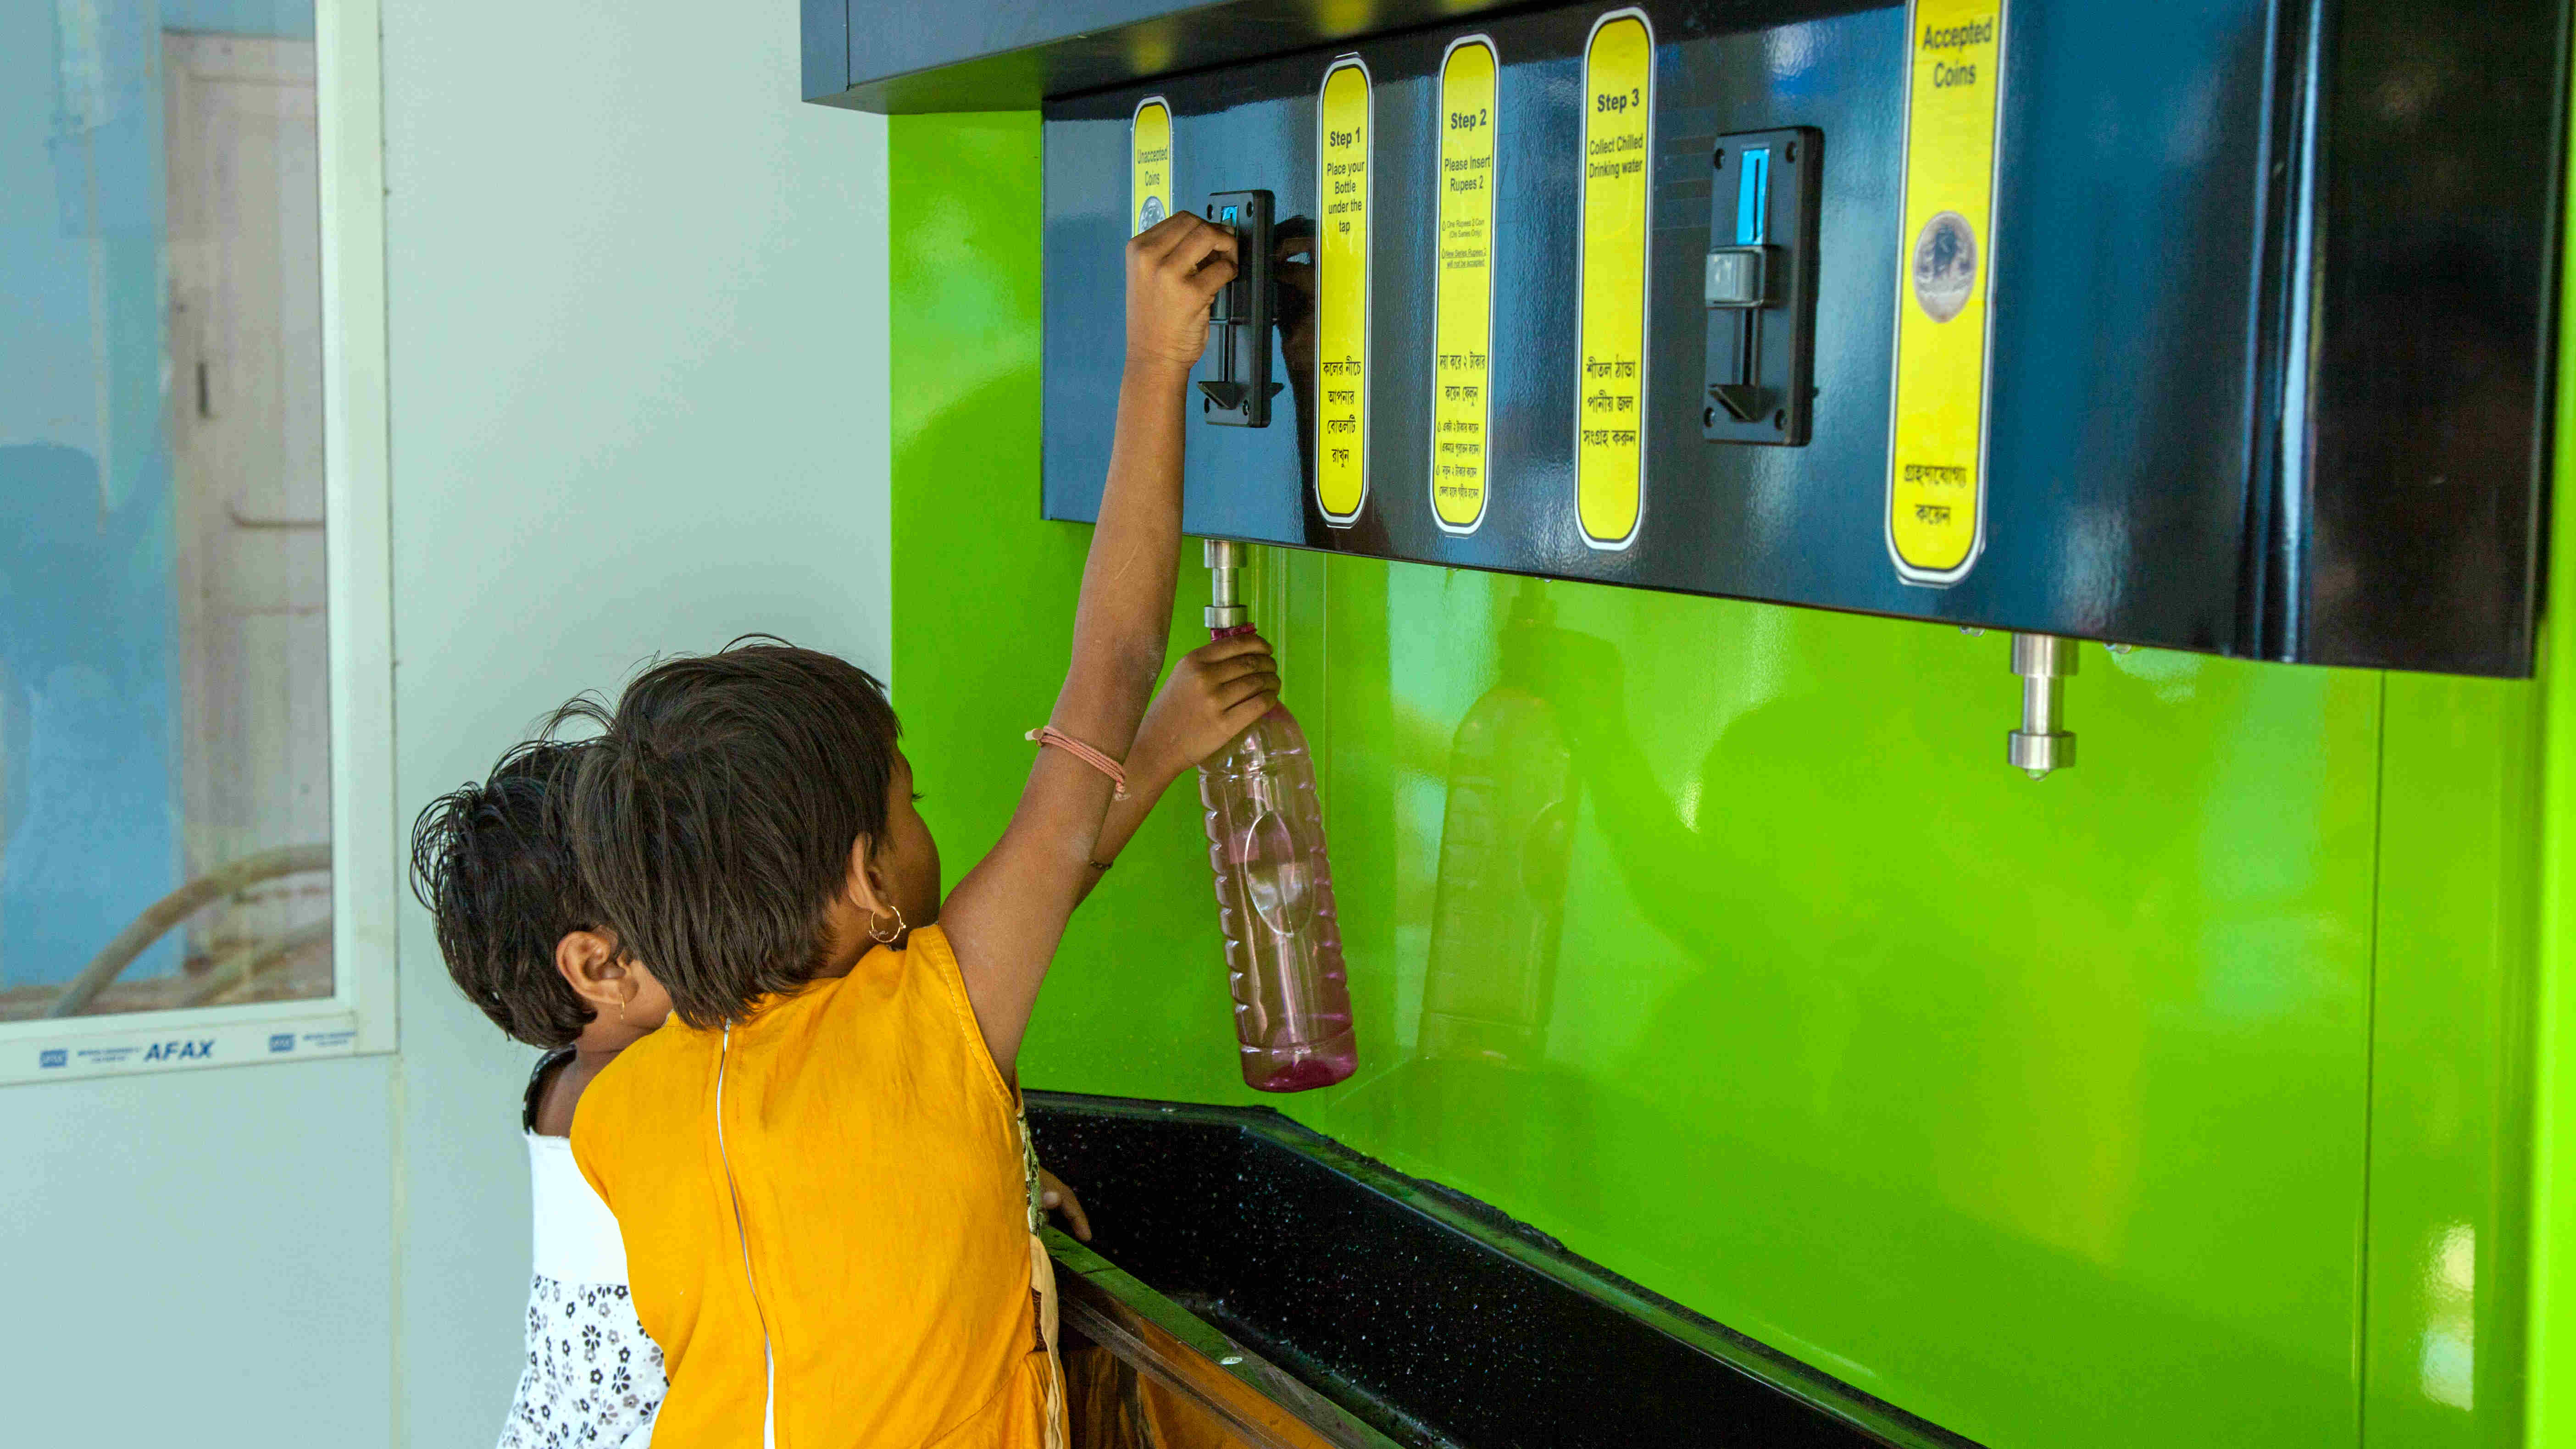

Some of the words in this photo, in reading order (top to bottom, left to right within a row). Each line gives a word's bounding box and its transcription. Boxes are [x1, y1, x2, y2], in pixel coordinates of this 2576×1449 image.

[1922, 16, 1993, 53] Accepted
[1934, 60, 1976, 87] Coins
[1597, 94, 1627, 114] Step
[1631, 88, 1639, 107] 3
[1451, 112, 1476, 131] Step
[1480, 108, 1487, 126] 2
[1330, 131, 1352, 148] Step
[1355, 126, 1360, 143] 1
[1590, 139, 1615, 155] Collect
[1617, 133, 1643, 152] Chilled
[1137, 144, 1167, 165] Unaccepted
[1444, 158, 1468, 172] Please
[1470, 154, 1491, 169] Insert
[1145, 170, 1160, 187] Coins
[1327, 162, 1346, 176] Place
[1348, 161, 1365, 177] your
[1589, 161, 1620, 178] Drinking
[1622, 159, 1643, 173] water
[1335, 179, 1356, 194] Bottle
[1450, 178, 1477, 194] Rupees
[1479, 175, 1483, 189] 2
[1328, 200, 1349, 214] under
[1351, 199, 1362, 212] the
[1339, 220, 1350, 234] tap
[1322, 362, 1344, 377] কলের
[1345, 355, 1361, 376] নীচে
[1587, 356, 1612, 378] শীতল
[1328, 390, 1354, 405] আপনার
[1588, 389, 1613, 413] পানীয়
[1616, 396, 1633, 413] জল
[1327, 414, 1356, 434] বোতলটি
[1583, 428, 1610, 449] সংগ্রহ
[1611, 430, 1636, 446] করুন
[1332, 448, 1349, 468] রাখুন
[1915, 503, 1951, 527] কয়েন
[144, 1039, 216, 1063] AFAX
